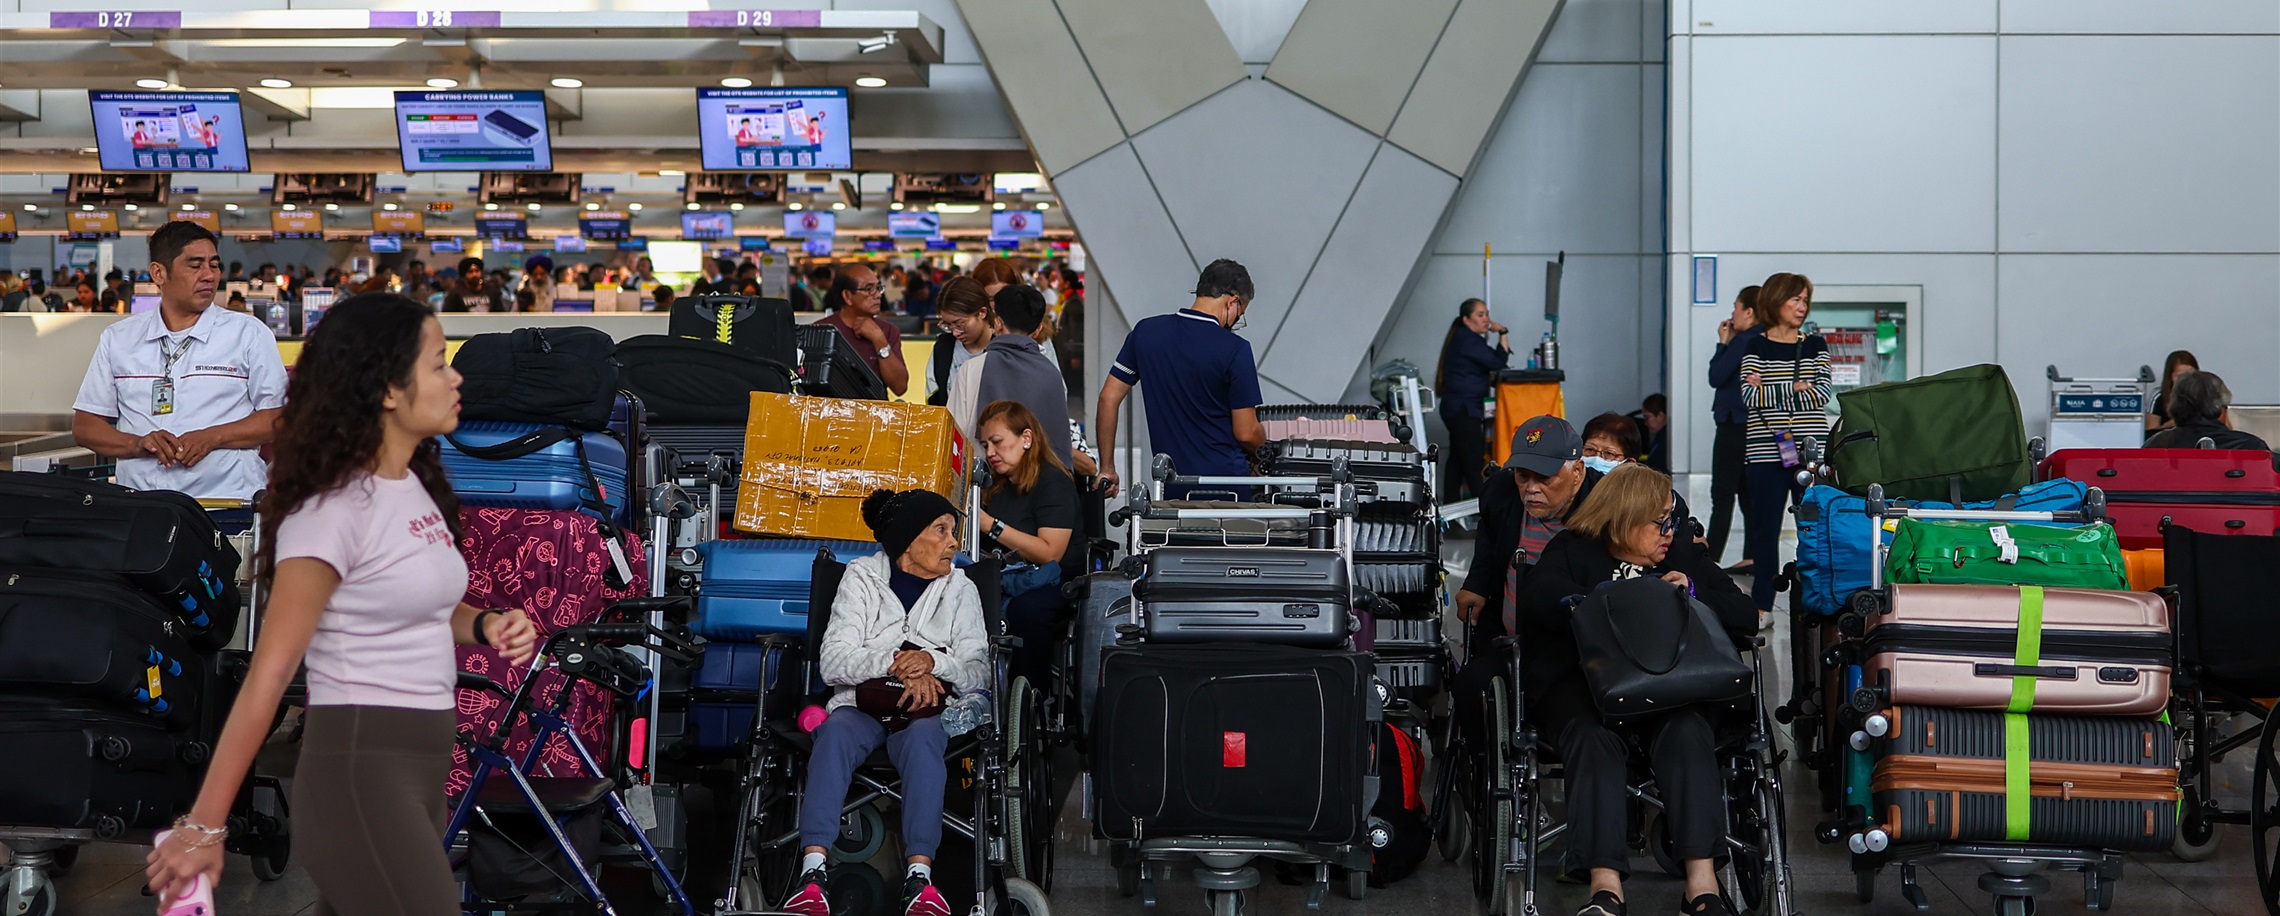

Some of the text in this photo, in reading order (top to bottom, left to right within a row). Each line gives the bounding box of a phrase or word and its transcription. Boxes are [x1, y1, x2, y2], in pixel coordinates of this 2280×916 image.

[98, 12, 132, 28] D 27
[416, 10, 453, 27] D 28
[737, 10, 772, 26] D 29
[424, 93, 514, 101] CARRYING POWER BANKS
[1229, 568, 1256, 576] CHIVAS
